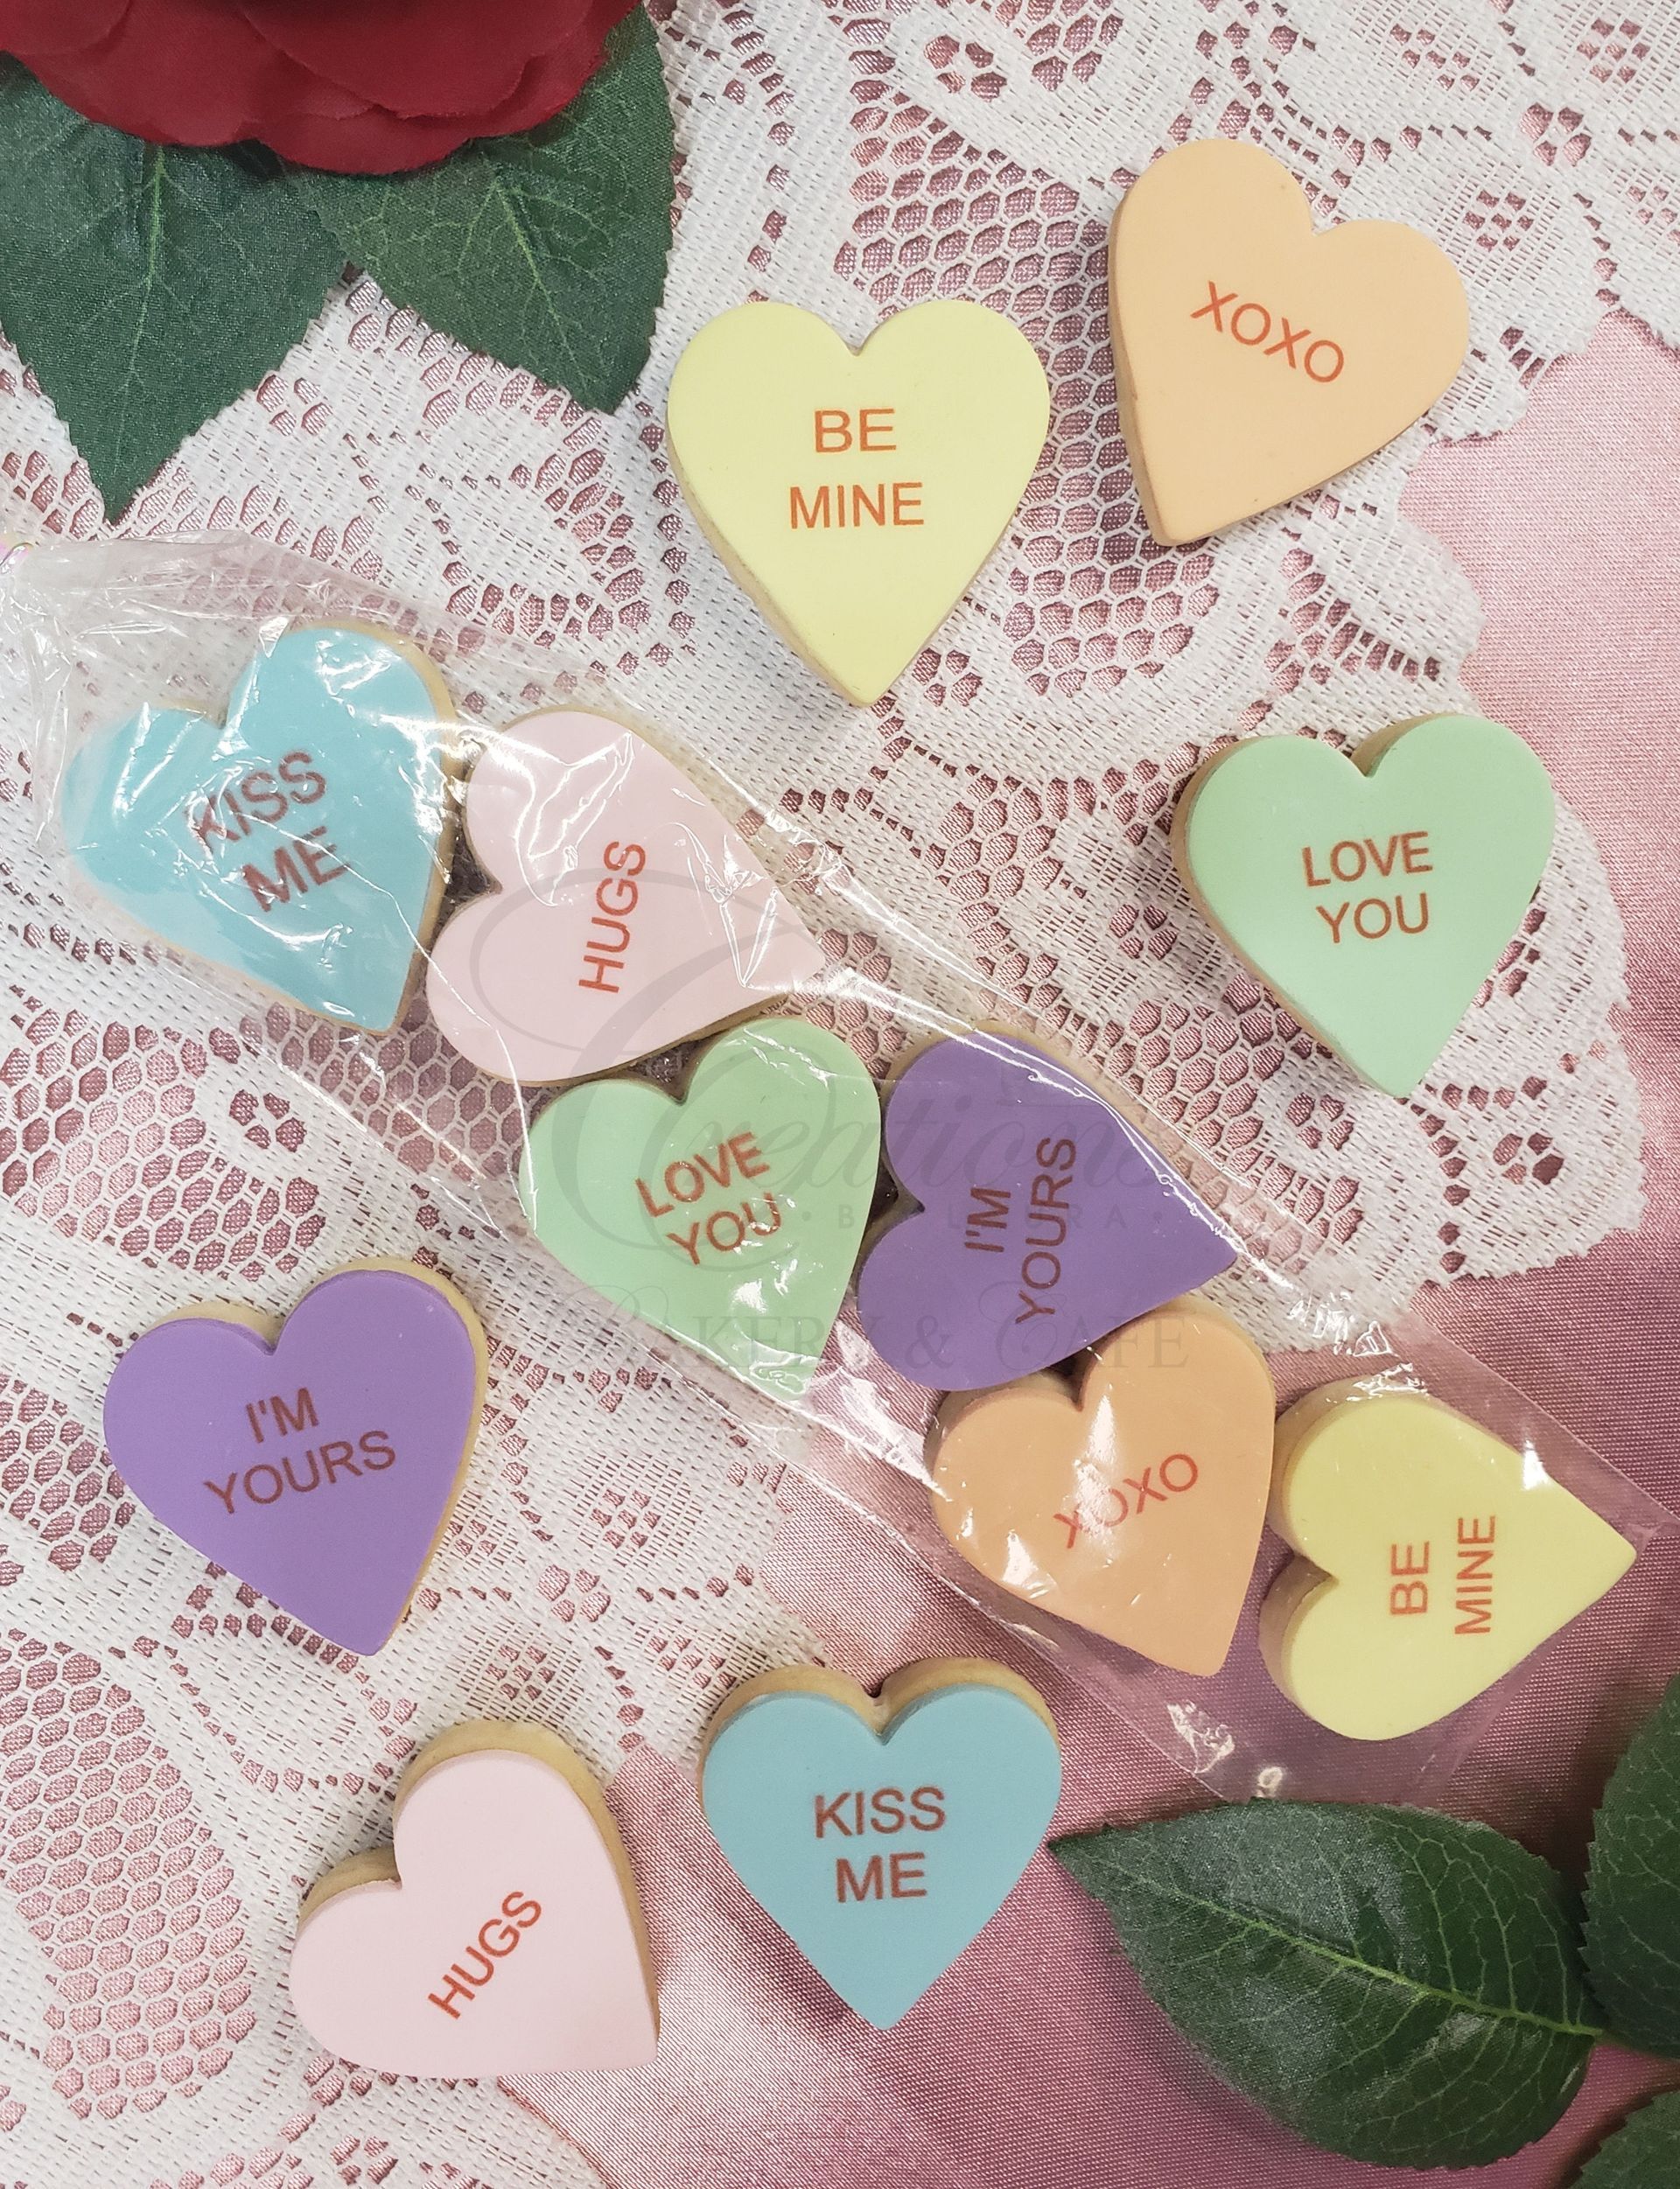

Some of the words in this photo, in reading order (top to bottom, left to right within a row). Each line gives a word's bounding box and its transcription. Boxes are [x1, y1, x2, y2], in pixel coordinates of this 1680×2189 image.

[1190, 280, 1345, 383] XOXO
[814, 408, 897, 453] BE
[789, 481, 924, 529] MINE
[183, 752, 326, 855] KISS
[241, 826, 350, 912] ME
[1302, 830, 1433, 887] LOVE
[578, 841, 647, 994] HUGS
[1315, 892, 1429, 944] YOU
[635, 1131, 770, 1217] LOVE
[666, 1192, 782, 1266] YOU
[963, 1186, 1012, 1251] I'M
[1016, 1135, 1077, 1323] YOURS
[246, 1387, 319, 1444] I'M
[202, 1430, 396, 1514] YOURS
[1053, 1452, 1199, 1549] XOXO
[1390, 1541, 1430, 1616] BE
[1454, 1515, 1496, 1635] MINE
[814, 1786, 946, 1839] KISS
[836, 1852, 928, 1903] ME
[427, 1891, 542, 2020] HUGS
